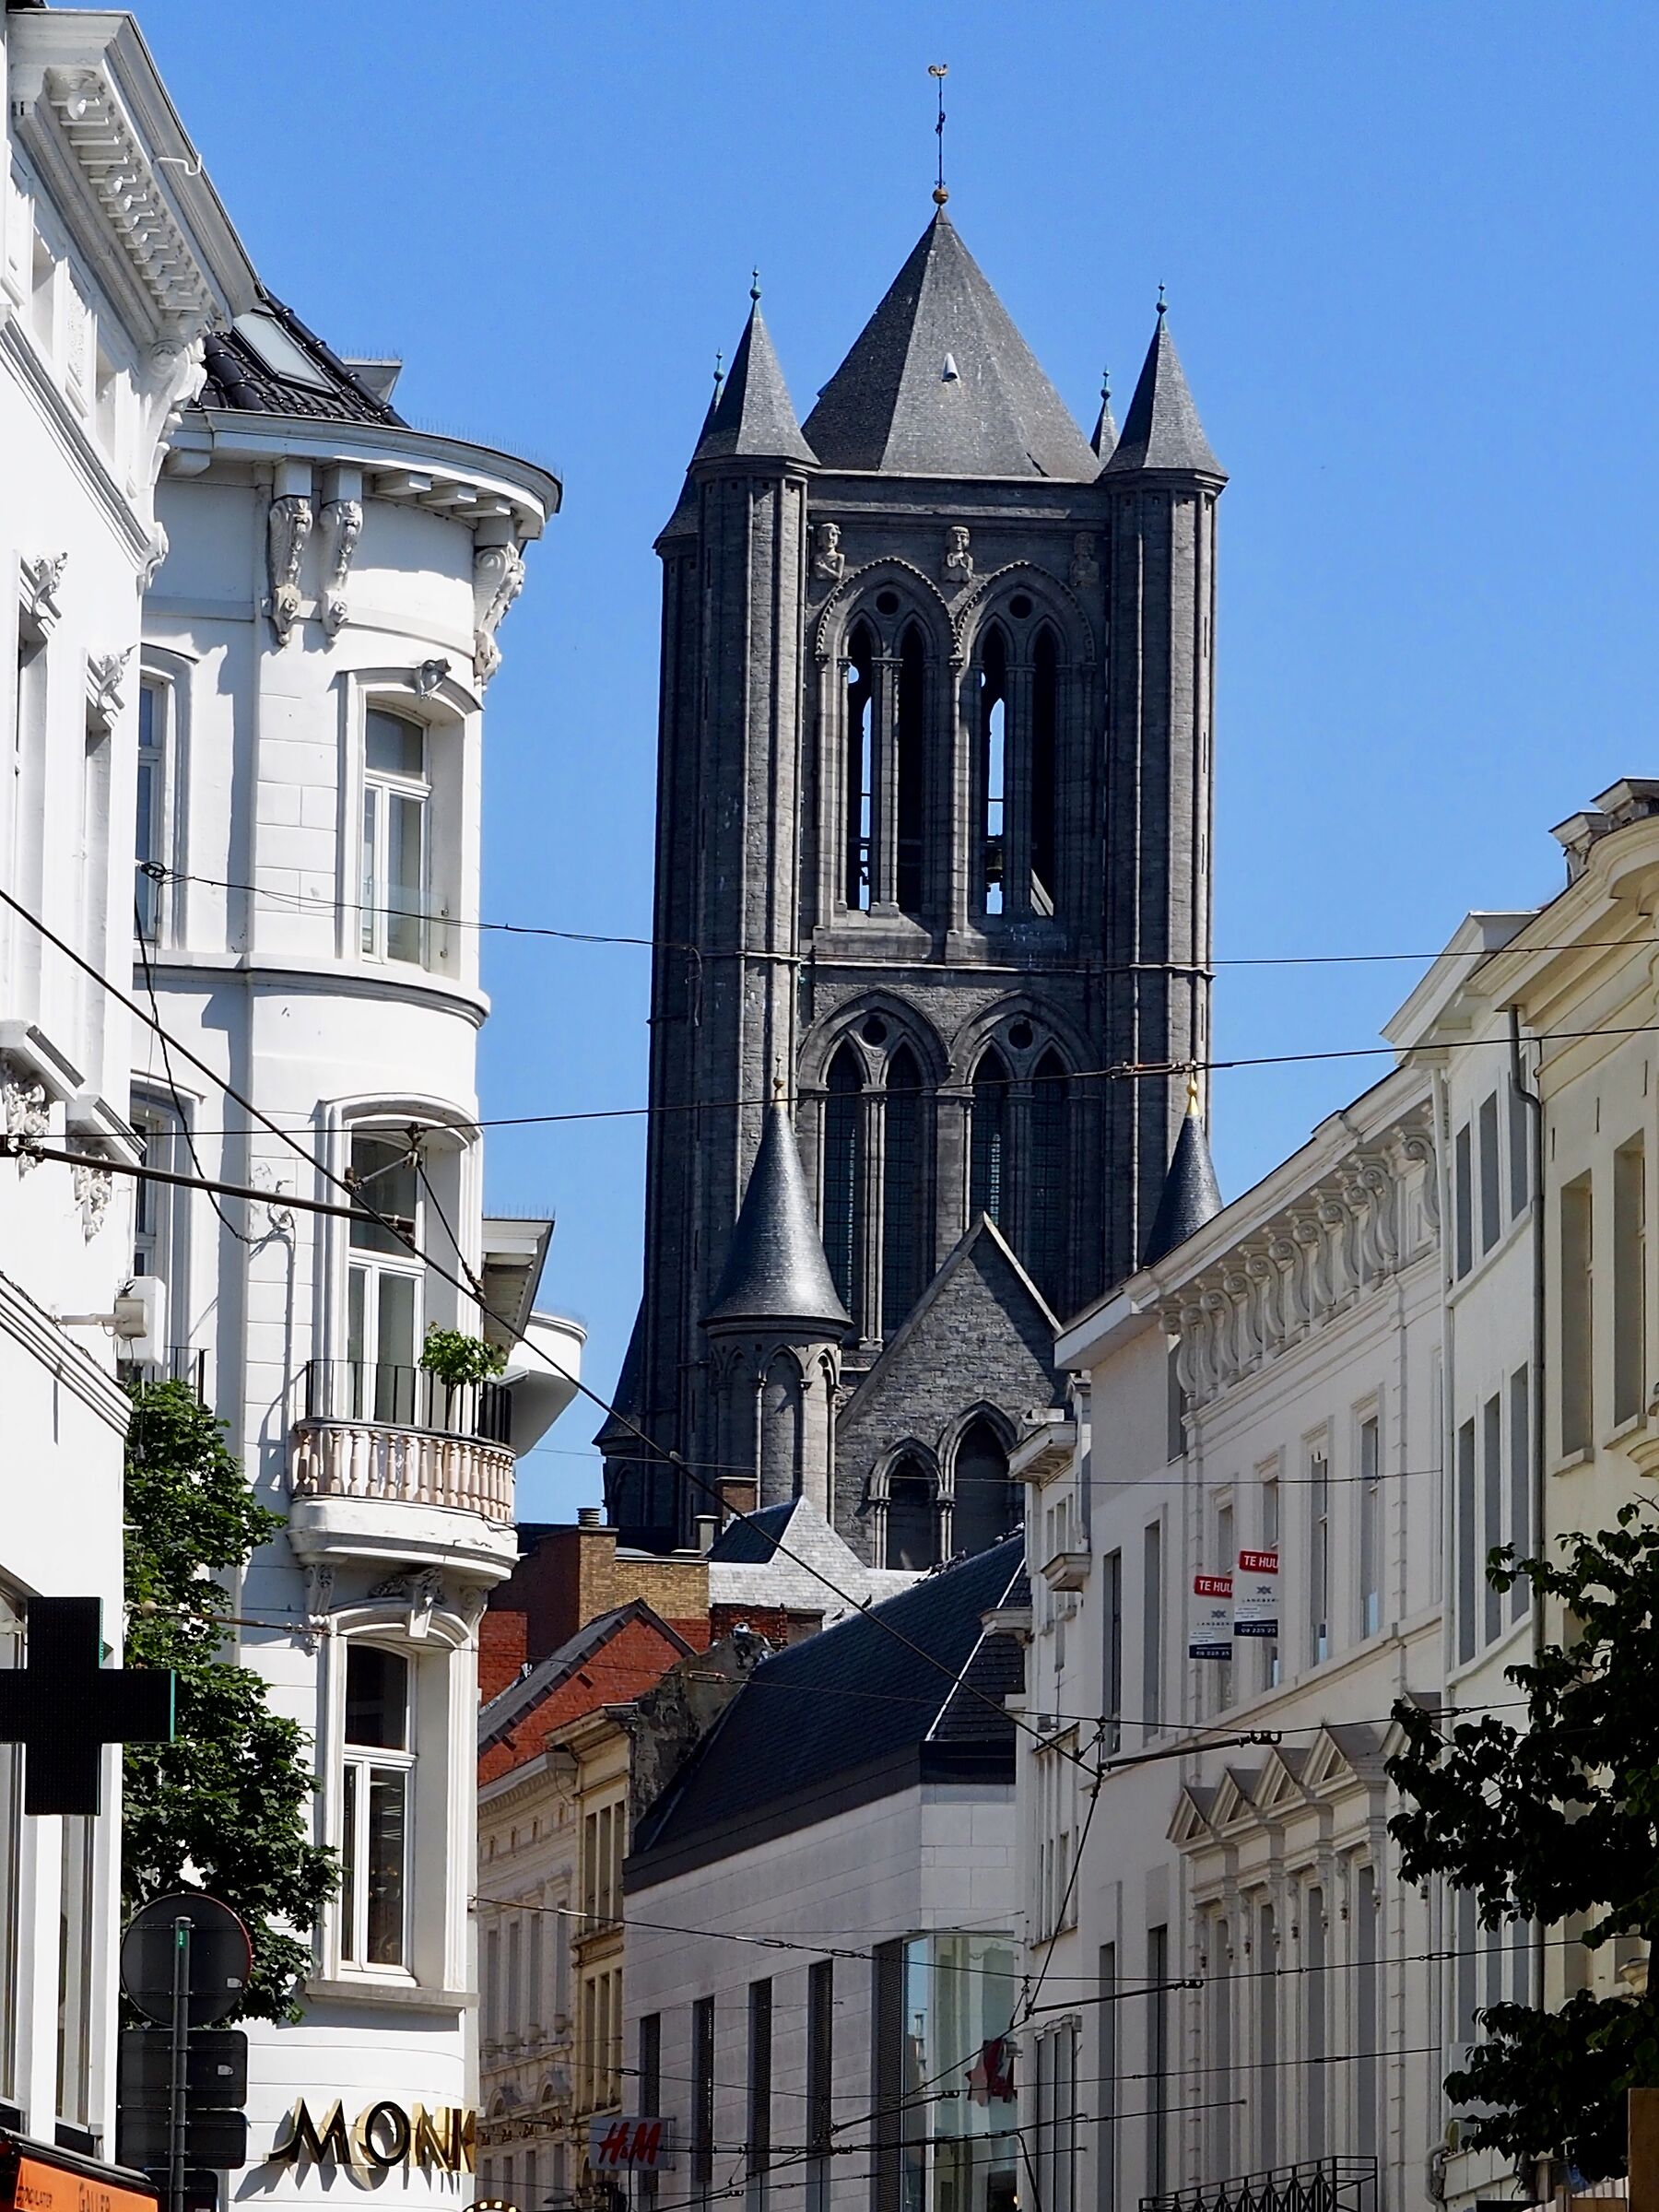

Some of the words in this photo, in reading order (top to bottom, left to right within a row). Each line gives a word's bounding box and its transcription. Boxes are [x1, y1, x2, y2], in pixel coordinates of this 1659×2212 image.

[1243, 1555, 1256, 1567] TE
[1199, 1580, 1211, 1592] TE
[597, 2122, 662, 2166] H&M
